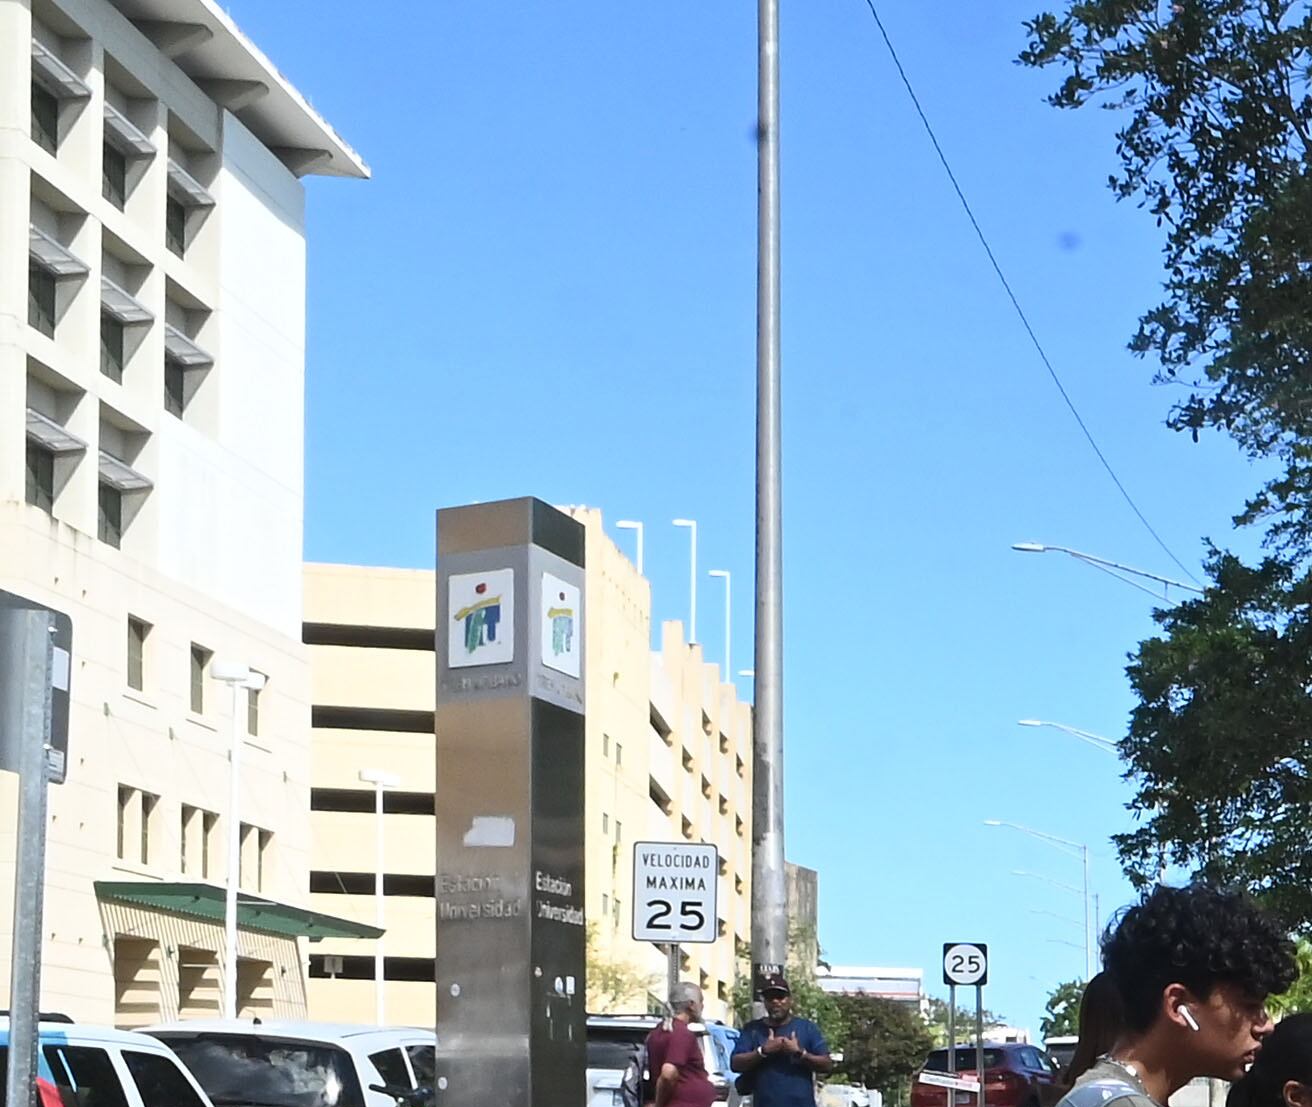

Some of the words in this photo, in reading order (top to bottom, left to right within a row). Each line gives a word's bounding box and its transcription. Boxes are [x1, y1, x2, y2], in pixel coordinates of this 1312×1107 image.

[642, 853, 710, 869] VELOCIDAD
[646, 875, 706, 891] MAXIMA
[646, 899, 705, 931] 25
[951, 954, 981, 974] 25
